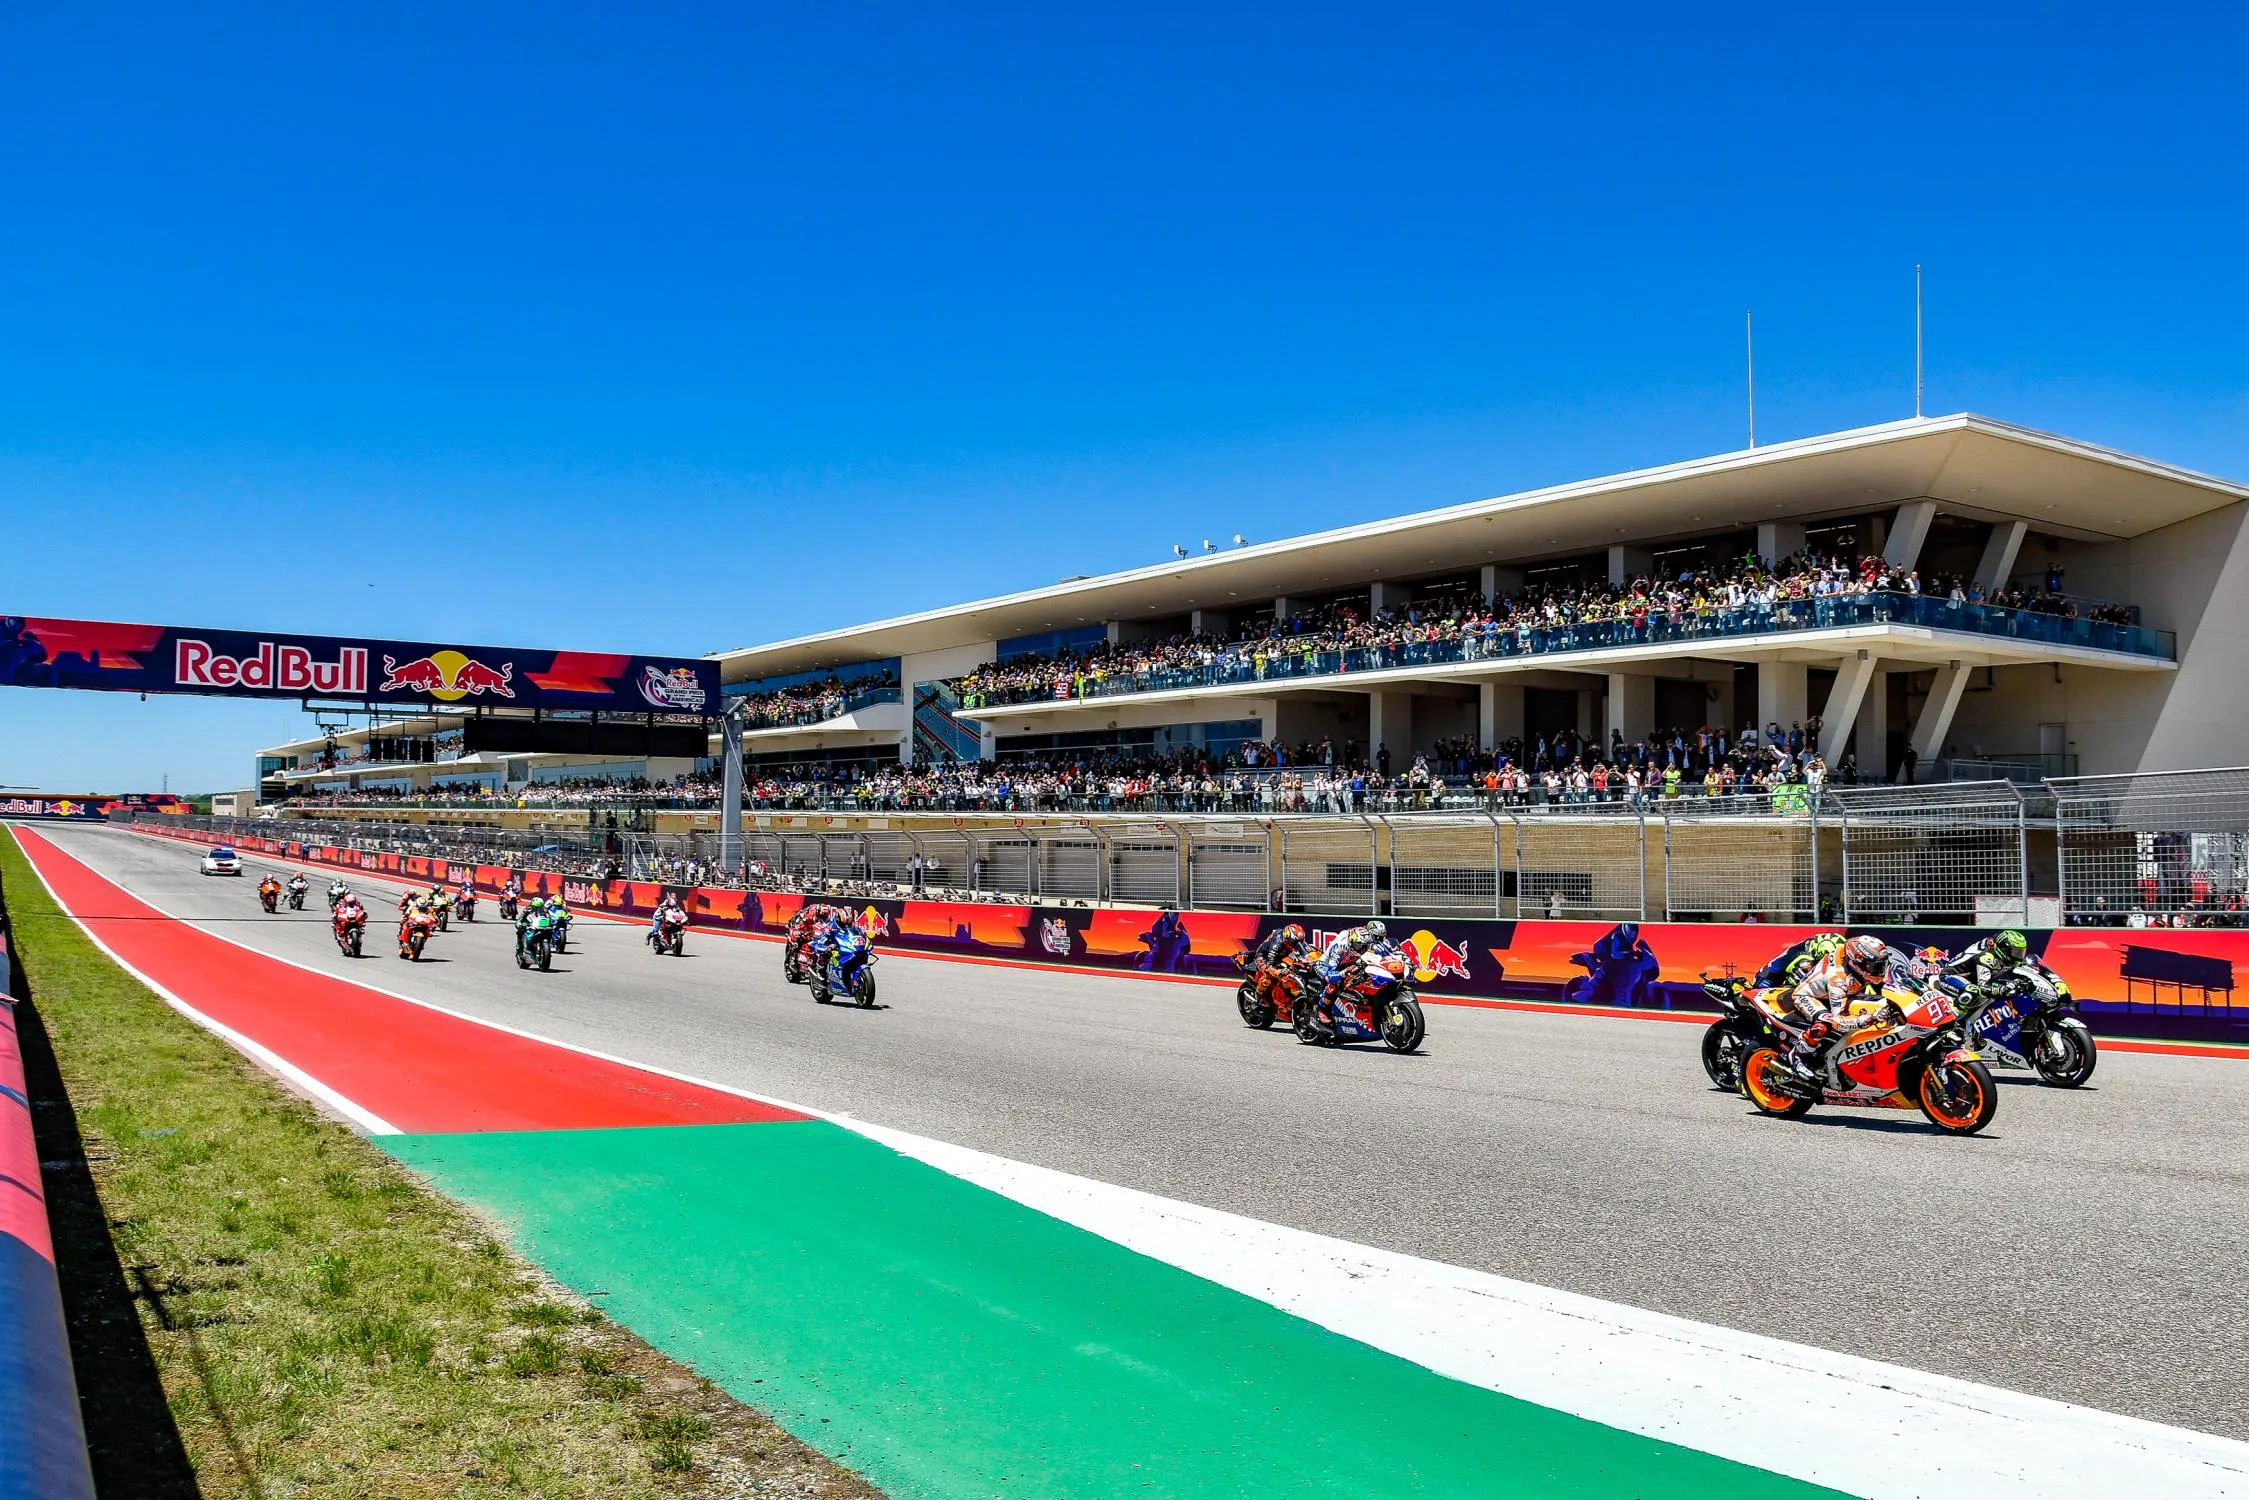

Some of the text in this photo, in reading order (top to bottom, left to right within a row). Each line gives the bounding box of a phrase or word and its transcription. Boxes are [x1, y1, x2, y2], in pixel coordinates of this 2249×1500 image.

[175, 638, 368, 693] Red Bull
[0, 799, 16, 812] ed
[1926, 997, 1953, 1025] 93
[1844, 1031, 1907, 1060] REPSOL
[1988, 1045, 2021, 1065] LAVOR
